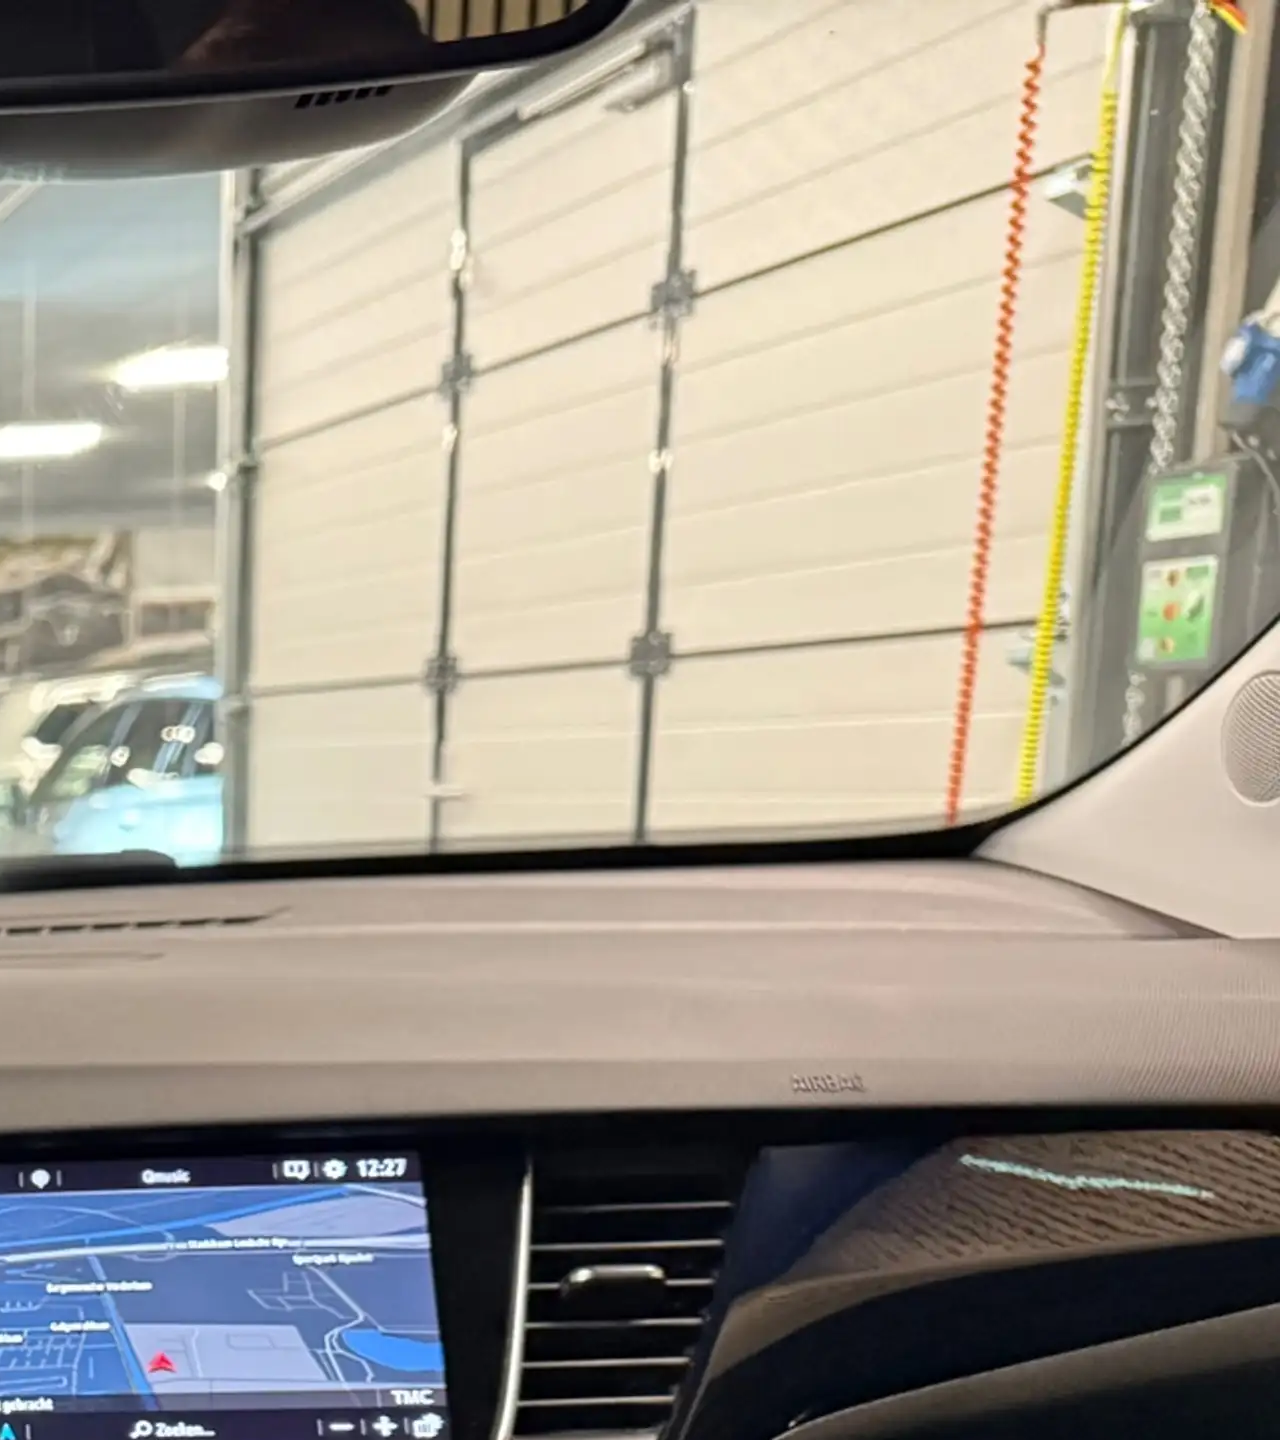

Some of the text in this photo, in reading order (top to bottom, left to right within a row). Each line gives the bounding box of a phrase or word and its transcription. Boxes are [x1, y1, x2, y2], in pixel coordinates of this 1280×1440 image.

[792, 1072, 867, 1094] AIRBAG
[141, 1168, 191, 1184] Qmusic
[357, 1157, 407, 1178] 12:27
[390, 1389, 436, 1406] TMC
